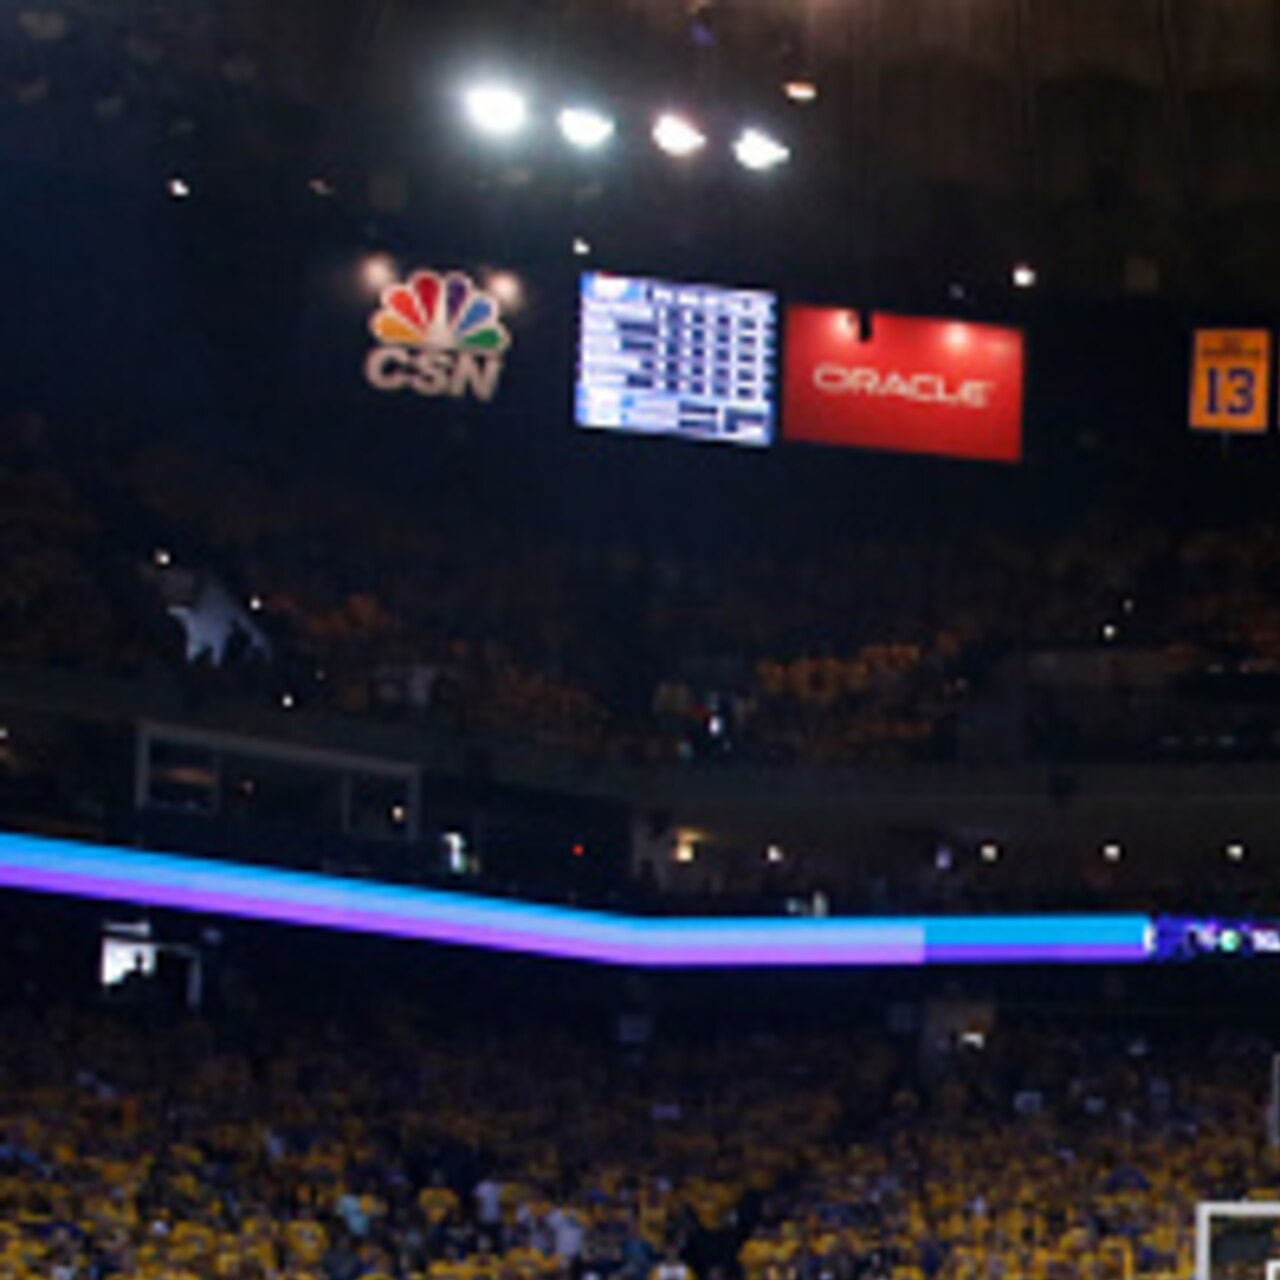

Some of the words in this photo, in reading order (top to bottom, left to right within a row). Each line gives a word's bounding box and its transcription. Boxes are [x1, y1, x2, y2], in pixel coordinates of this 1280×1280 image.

[366, 347, 501, 400] CSN
[813, 363, 995, 409] ORACLE
[1205, 368, 1256, 416] 13
